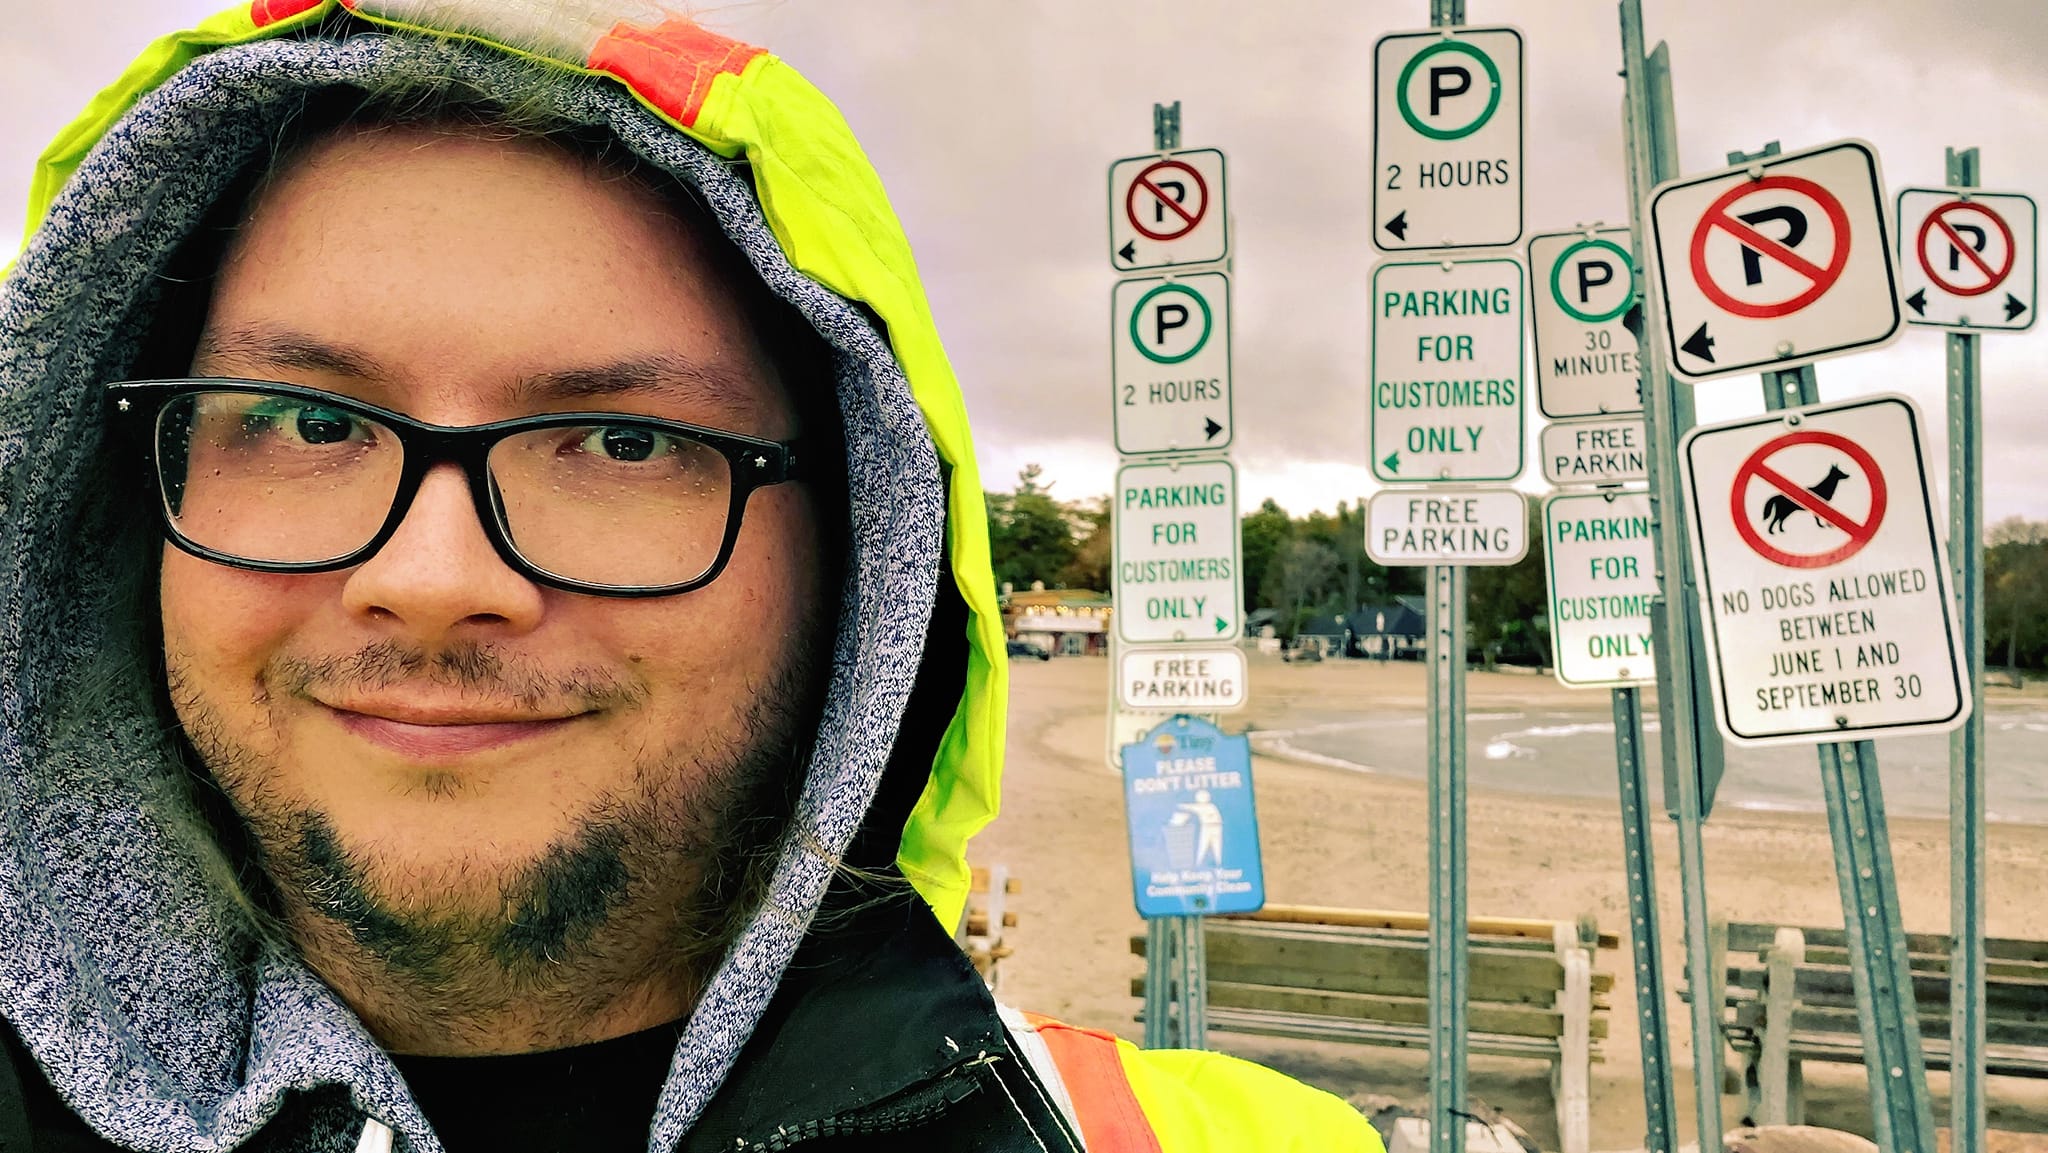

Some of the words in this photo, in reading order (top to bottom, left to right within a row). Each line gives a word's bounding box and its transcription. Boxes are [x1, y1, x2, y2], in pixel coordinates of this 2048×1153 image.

[1430, 66, 1471, 116] P
[1387, 164, 1401, 190] 2
[1420, 159, 1508, 188] HOURS
[1155, 181, 1185, 222] P
[1736, 206, 1808, 287] P
[1950, 224, 1987, 272] P
[1578, 261, 1613, 303] P
[1384, 288, 1510, 318] PARKING
[1157, 304, 1188, 345] P
[1418, 335, 1473, 362] FOR
[1585, 331, 1611, 351] 30
[1123, 384, 1136, 406] 2
[1149, 379, 1221, 404] HOURS
[1378, 379, 1515, 409] CUSTOMERS
[1408, 426, 1483, 453] ONLY
[1576, 428, 1635, 450] FREE
[1556, 452, 1643, 476] PARKIN
[1125, 484, 1225, 510] PARKING
[1409, 499, 1478, 523] FREE
[1153, 523, 1196, 545] FOR
[1384, 527, 1509, 552] PARKING
[1557, 516, 1648, 544] PARKIN
[1122, 558, 1230, 583] CUSTOMERS
[1590, 556, 1639, 580] FOR
[1722, 590, 1749, 615] NO
[1762, 583, 1814, 611] DOGS
[1829, 568, 1926, 602] ALLOWED
[1147, 596, 1207, 619] ONLY
[1781, 608, 1876, 641] BETWEEN
[1589, 633, 1653, 659] ONLY
[1769, 649, 1823, 677] JUNE
[1857, 642, 1900, 668] AND
[1154, 659, 1210, 677] FREE
[1133, 680, 1233, 698] PARKING
[1757, 678, 1881, 711] SEPTEMBER
[1894, 675, 1922, 700] 30
[1156, 756, 1217, 776] PLEASE
[1185, 771, 1242, 791] LITTER
